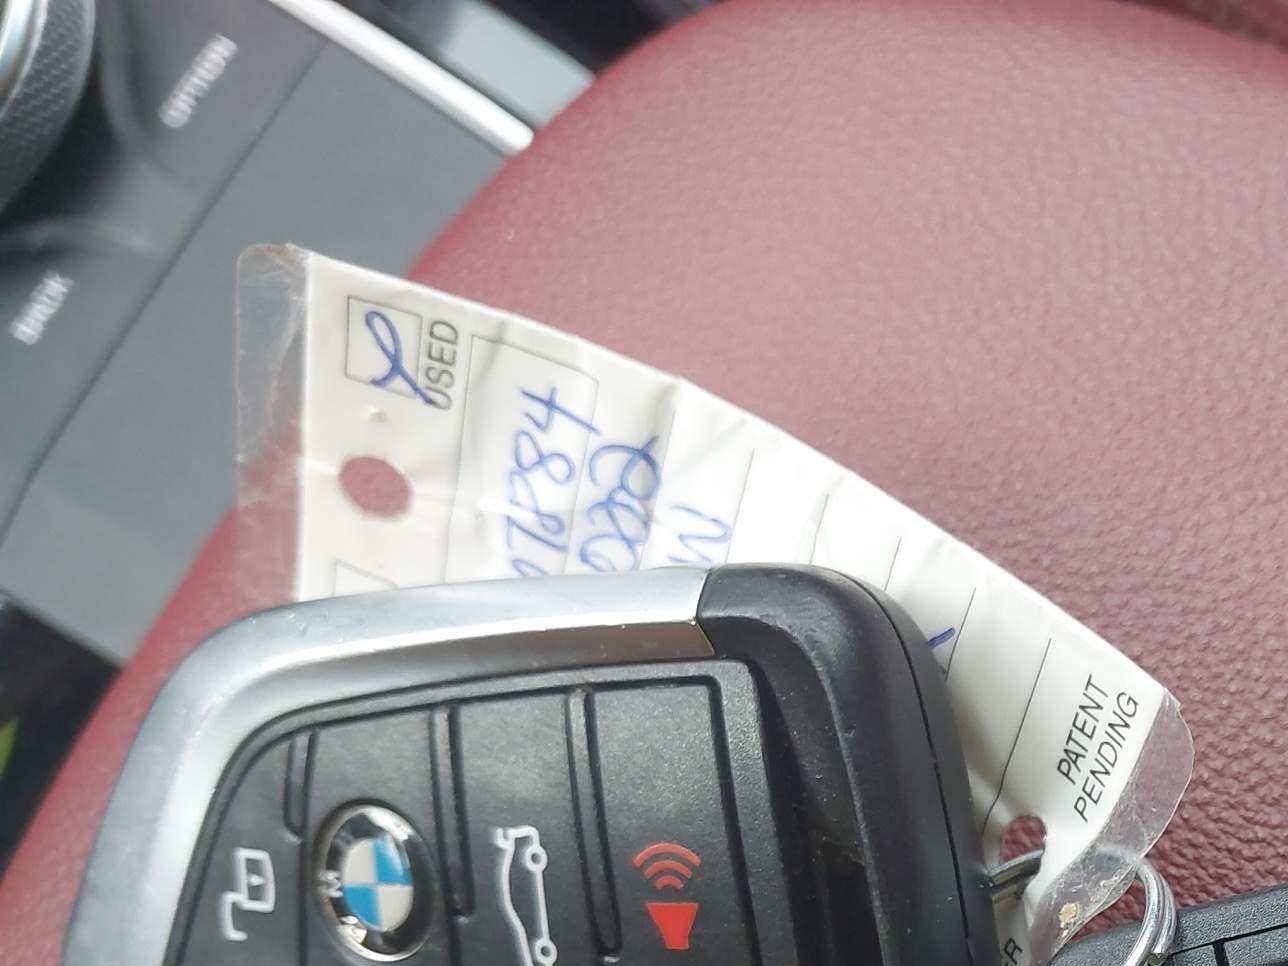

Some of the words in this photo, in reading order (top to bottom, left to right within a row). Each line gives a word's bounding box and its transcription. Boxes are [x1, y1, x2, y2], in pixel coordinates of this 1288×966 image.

[159, 34, 238, 128] OPTION
[424, 320, 459, 410] USED
[1056, 673, 1109, 785] PATENT
[1073, 691, 1140, 823] PENDING
